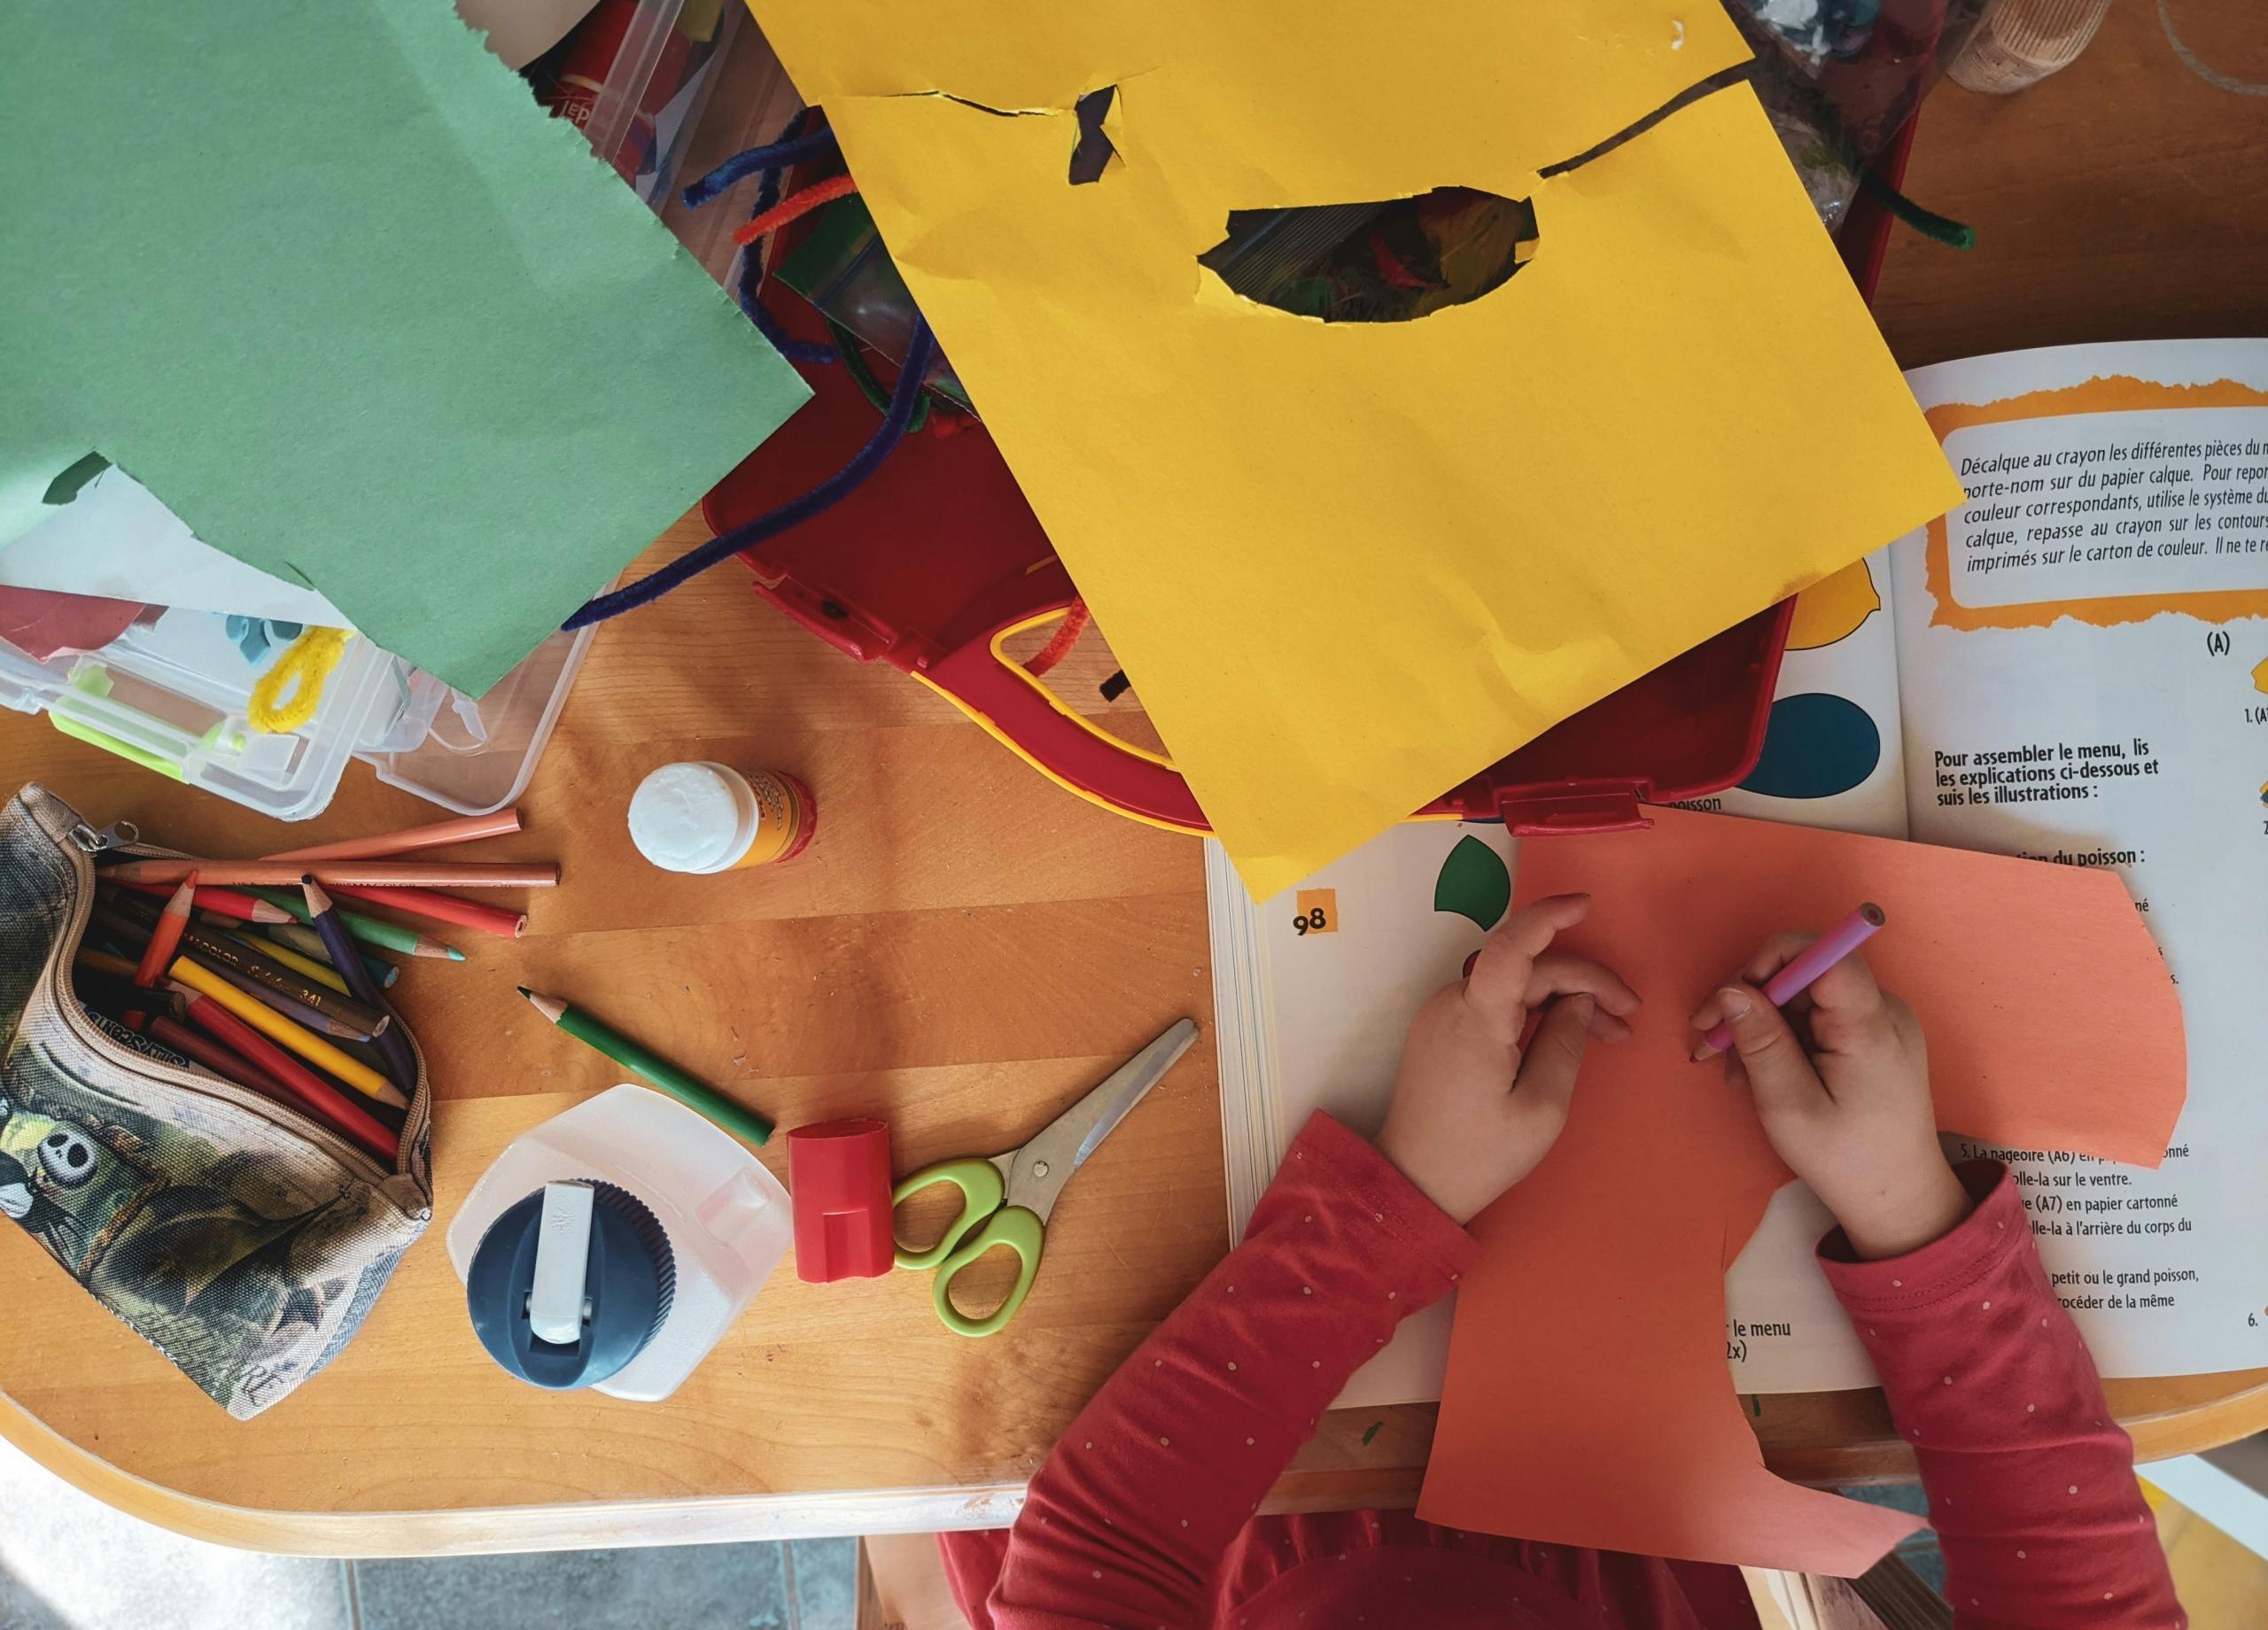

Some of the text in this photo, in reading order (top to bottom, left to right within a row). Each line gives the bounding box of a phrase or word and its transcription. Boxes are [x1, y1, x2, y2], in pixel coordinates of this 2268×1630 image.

[1961, 454, 2030, 476] Décalque
[2033, 454, 2052, 468] au
[2056, 449, 2106, 468] crayon
[2109, 443, 2127, 462] les
[2131, 441, 2202, 460] différentes
[2204, 439, 2241, 461] pièces
[2245, 438, 2259, 455] du
[2050, 476, 2073, 490] sur
[2078, 470, 2096, 488] du
[2101, 468, 2145, 491] papier
[2149, 464, 2194, 486] calque.
[2203, 463, 2233, 481] Pour
[1964, 503, 2022, 524] couleur
[2025, 493, 2142, 517] correspondants,
[2147, 489, 2185, 508] utilise
[2189, 488, 2200, 506] le
[2204, 488, 2253, 509] système
[1966, 528, 2017, 549] calque,
[2027, 524, 2084, 544] repasse
[2090, 523, 2108, 536] au
[2116, 519, 2162, 537] crayon
[2170, 517, 2189, 532] sur
[2194, 513, 2211, 531] les
[1967, 550, 2037, 574] imprimés
[2042, 550, 2065, 565] sur
[2069, 545, 2082, 563] le
[2086, 543, 2132, 562] carton
[2137, 540, 2153, 558] de
[2157, 538, 2208, 557] couleur.
[2216, 536, 2223, 555] Il
[2226, 539, 2241, 554] ne
[2245, 539, 2256, 553] te
[2207, 631, 2230, 656] (A)
[2244, 708, 2253, 723] 1.
[1934, 738, 2149, 767] Pour assembler le menu, lis
[1936, 758, 2159, 788] les explications ci-dessous et
[1938, 788, 1964, 806] suis
[1969, 787, 1990, 805] les
[1994, 783, 2089, 803] illustrations
[2078, 848, 2136, 866] poisson
[1293, 907, 1326, 935] 98
[299, 990, 322, 1007] 341
[1961, 1143, 1970, 1159] 5.
[1973, 1145, 1987, 1160] La
[2053, 1176, 2072, 1186] sur
[2076, 1171, 2086, 1186] le
[2089, 1174, 2132, 1186] ventre.
[2036, 1194, 2062, 1214] (A7)
[2066, 1199, 2081, 1210] en
[2085, 1196, 2123, 1214] papier
[2126, 1194, 2178, 1210] cartonné
[2066, 1222, 2073, 1236] à
[2078, 1220, 2123, 1235] l'arrière
[2127, 1219, 2141, 1235] du
[2145, 1222, 2175, 1237] corps
[2179, 1217, 2192, 1231] du
[2052, 1268, 2199, 1287] petit ou le grand poisson,
[2108, 1294, 2123, 1308] de
[2125, 1293, 2136, 1308] la
[2140, 1293, 2174, 1308] même
[1733, 1319, 1790, 1337] le menu
[2248, 1312, 2258, 1327] 6.
